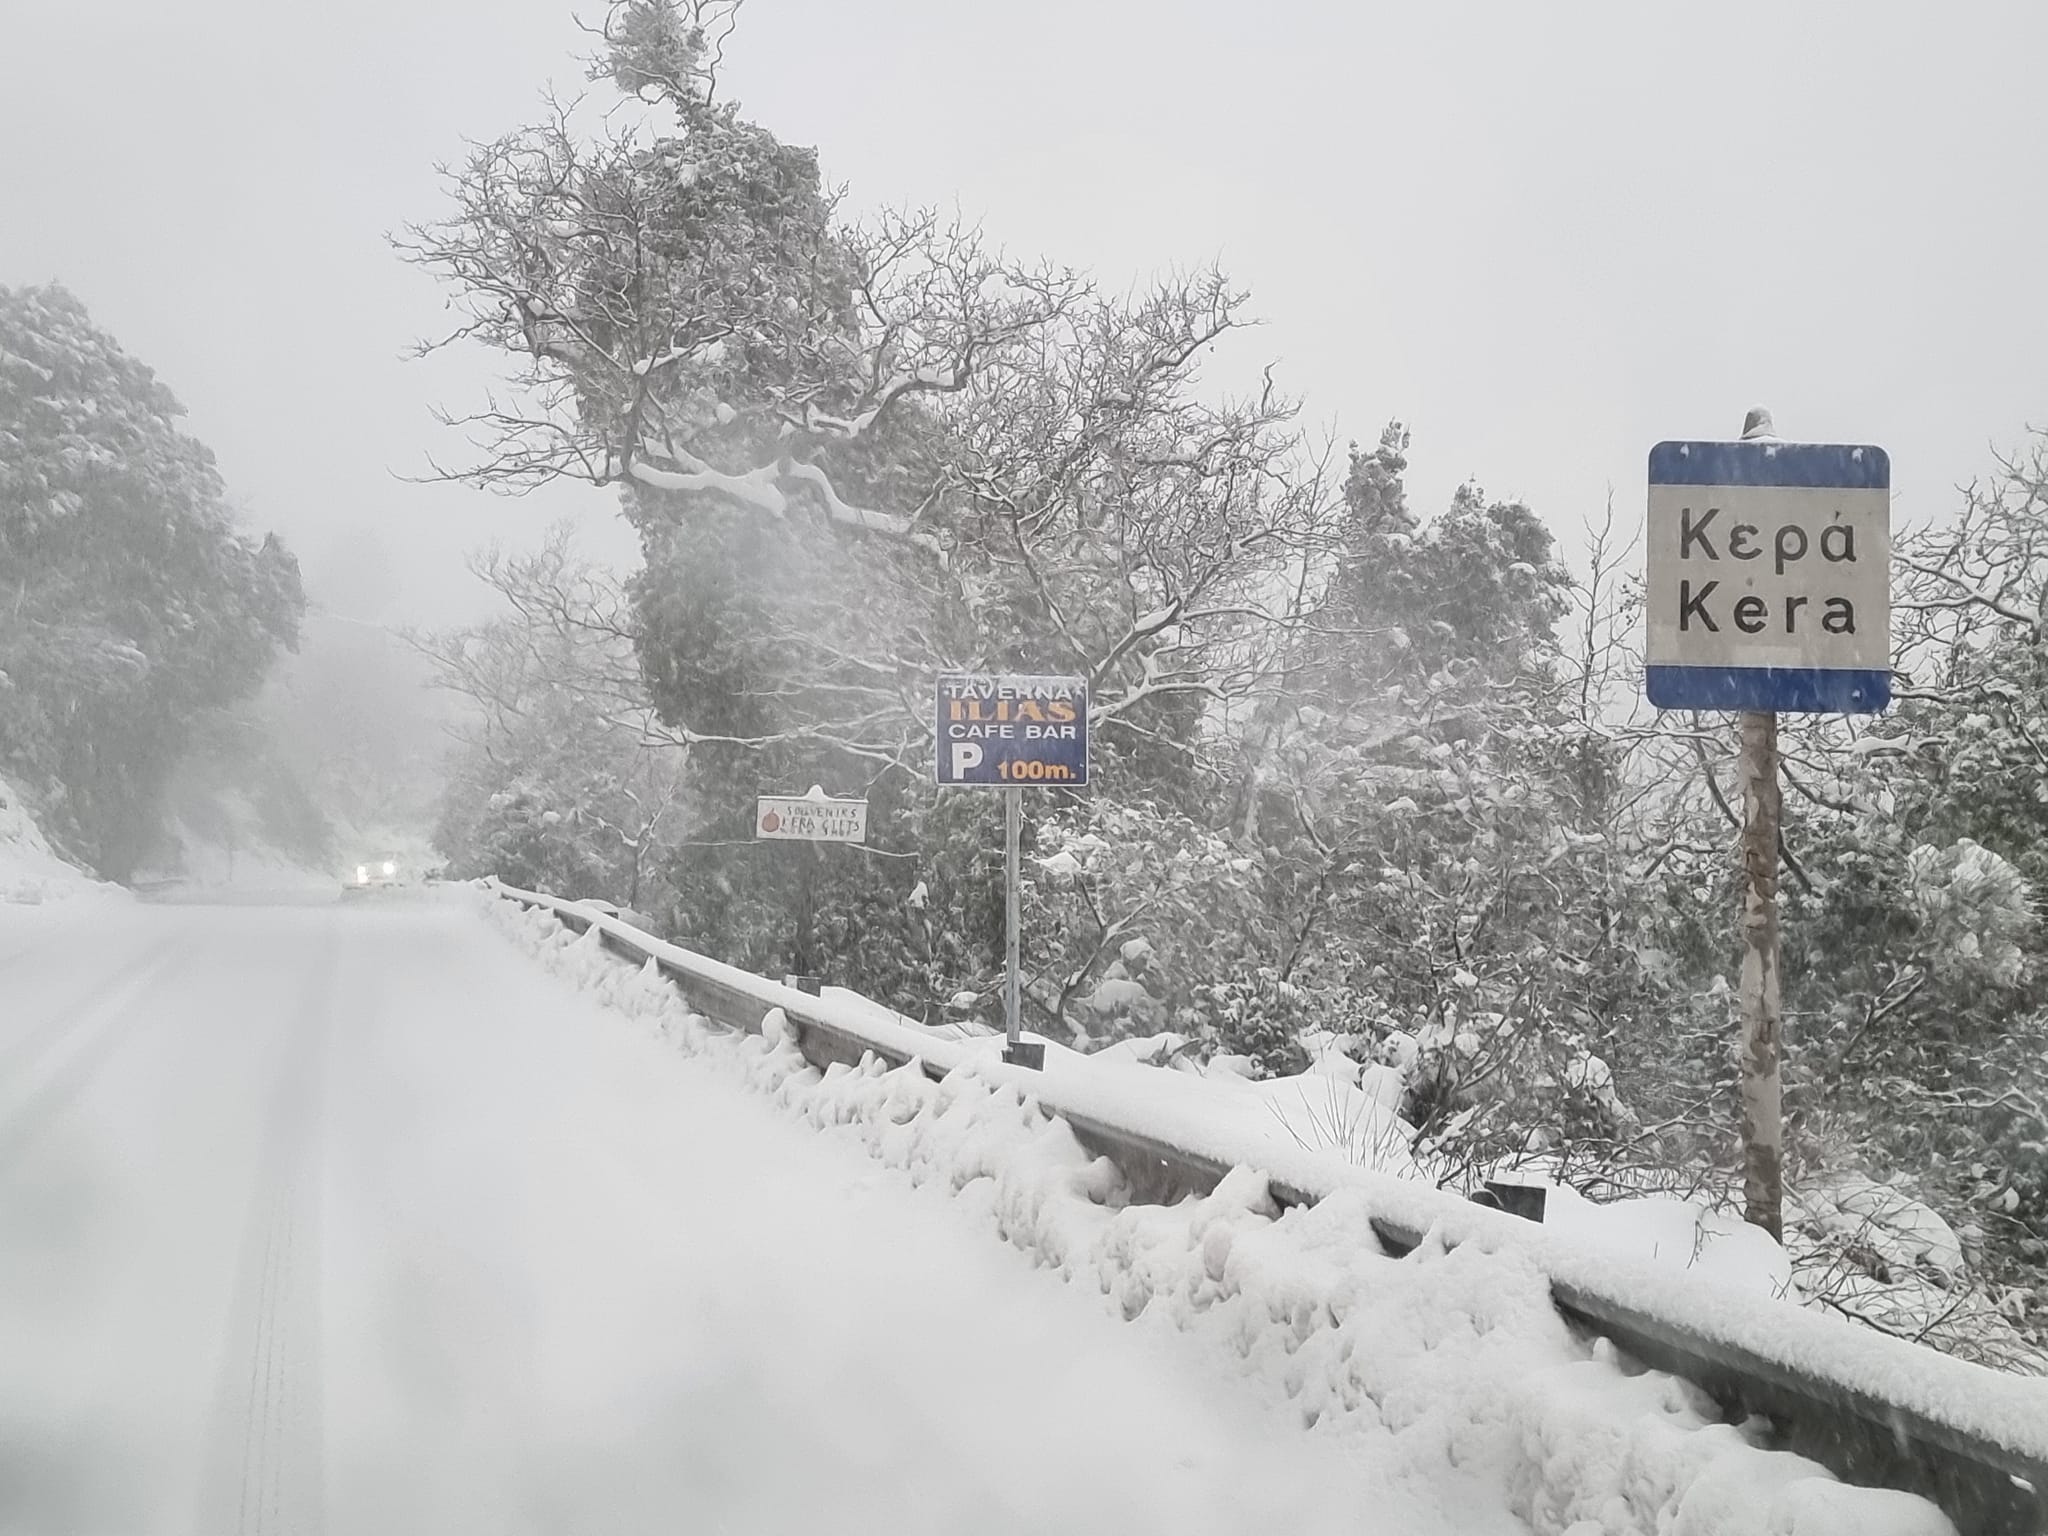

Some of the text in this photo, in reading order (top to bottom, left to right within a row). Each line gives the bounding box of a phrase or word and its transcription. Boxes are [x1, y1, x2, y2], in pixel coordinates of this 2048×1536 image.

[1680, 507, 1857, 576] Κερά
[1679, 580, 1857, 635] Kera
[947, 683, 1073, 700] TAVERNA
[950, 700, 1077, 722] ILIAS
[948, 724, 1077, 740] CAFE BAR
[951, 742, 1077, 780] P 100m.
